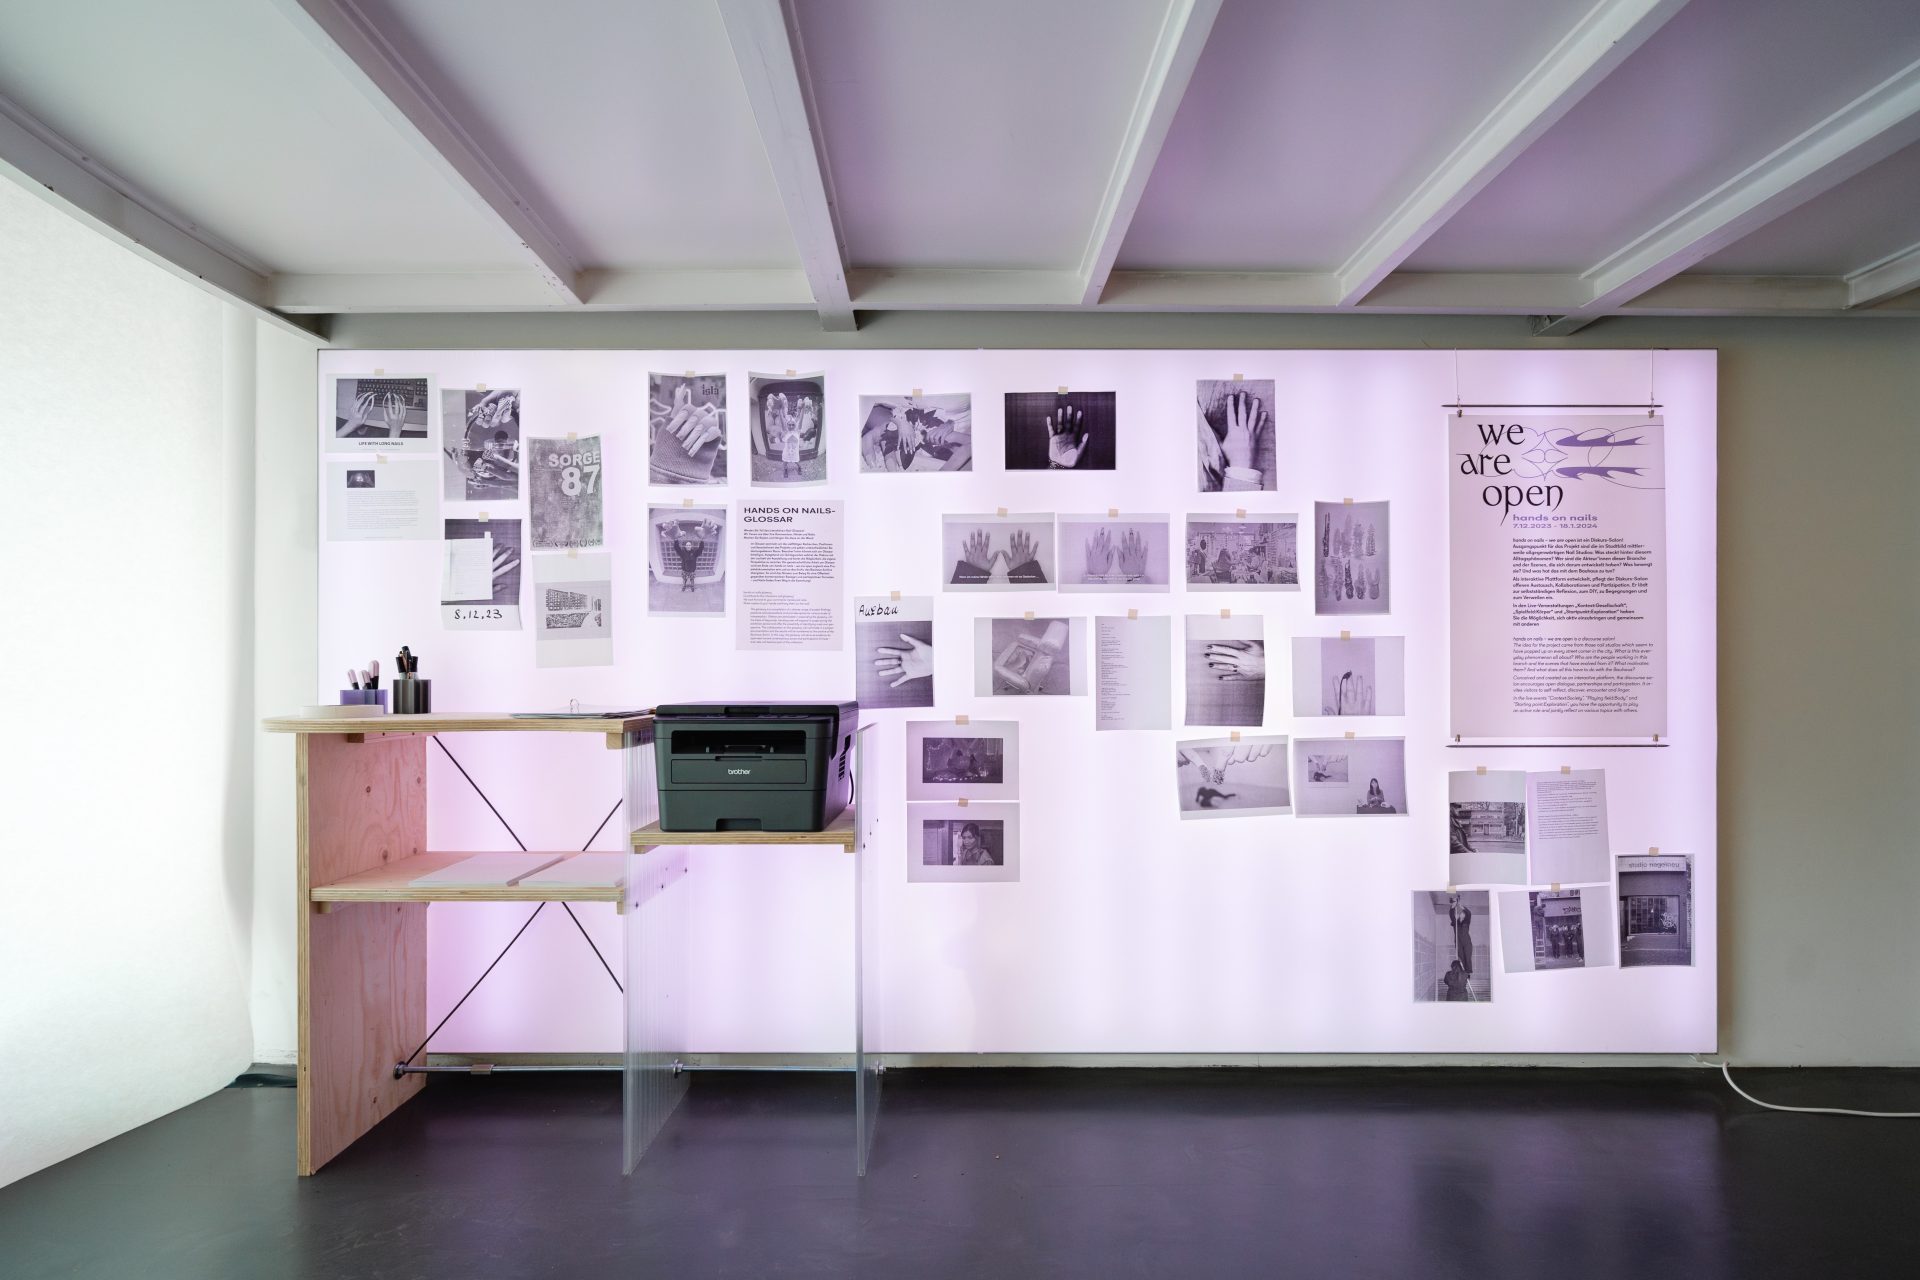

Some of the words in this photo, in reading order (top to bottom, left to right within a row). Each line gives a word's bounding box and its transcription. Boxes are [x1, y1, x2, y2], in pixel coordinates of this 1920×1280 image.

[1476, 423, 1525, 446] we
[548, 451, 601, 467] SORGE
[1455, 453, 1513, 475] are
[561, 464, 601, 497] 87
[801, 507, 836, 515] NAILS-
[1482, 484, 1563, 526] open
[1512, 514, 1549, 522] hands
[1569, 514, 1598, 522] nails
[454, 608, 503, 620] 8.12.23
[858, 603, 898, 617] Aufbau
